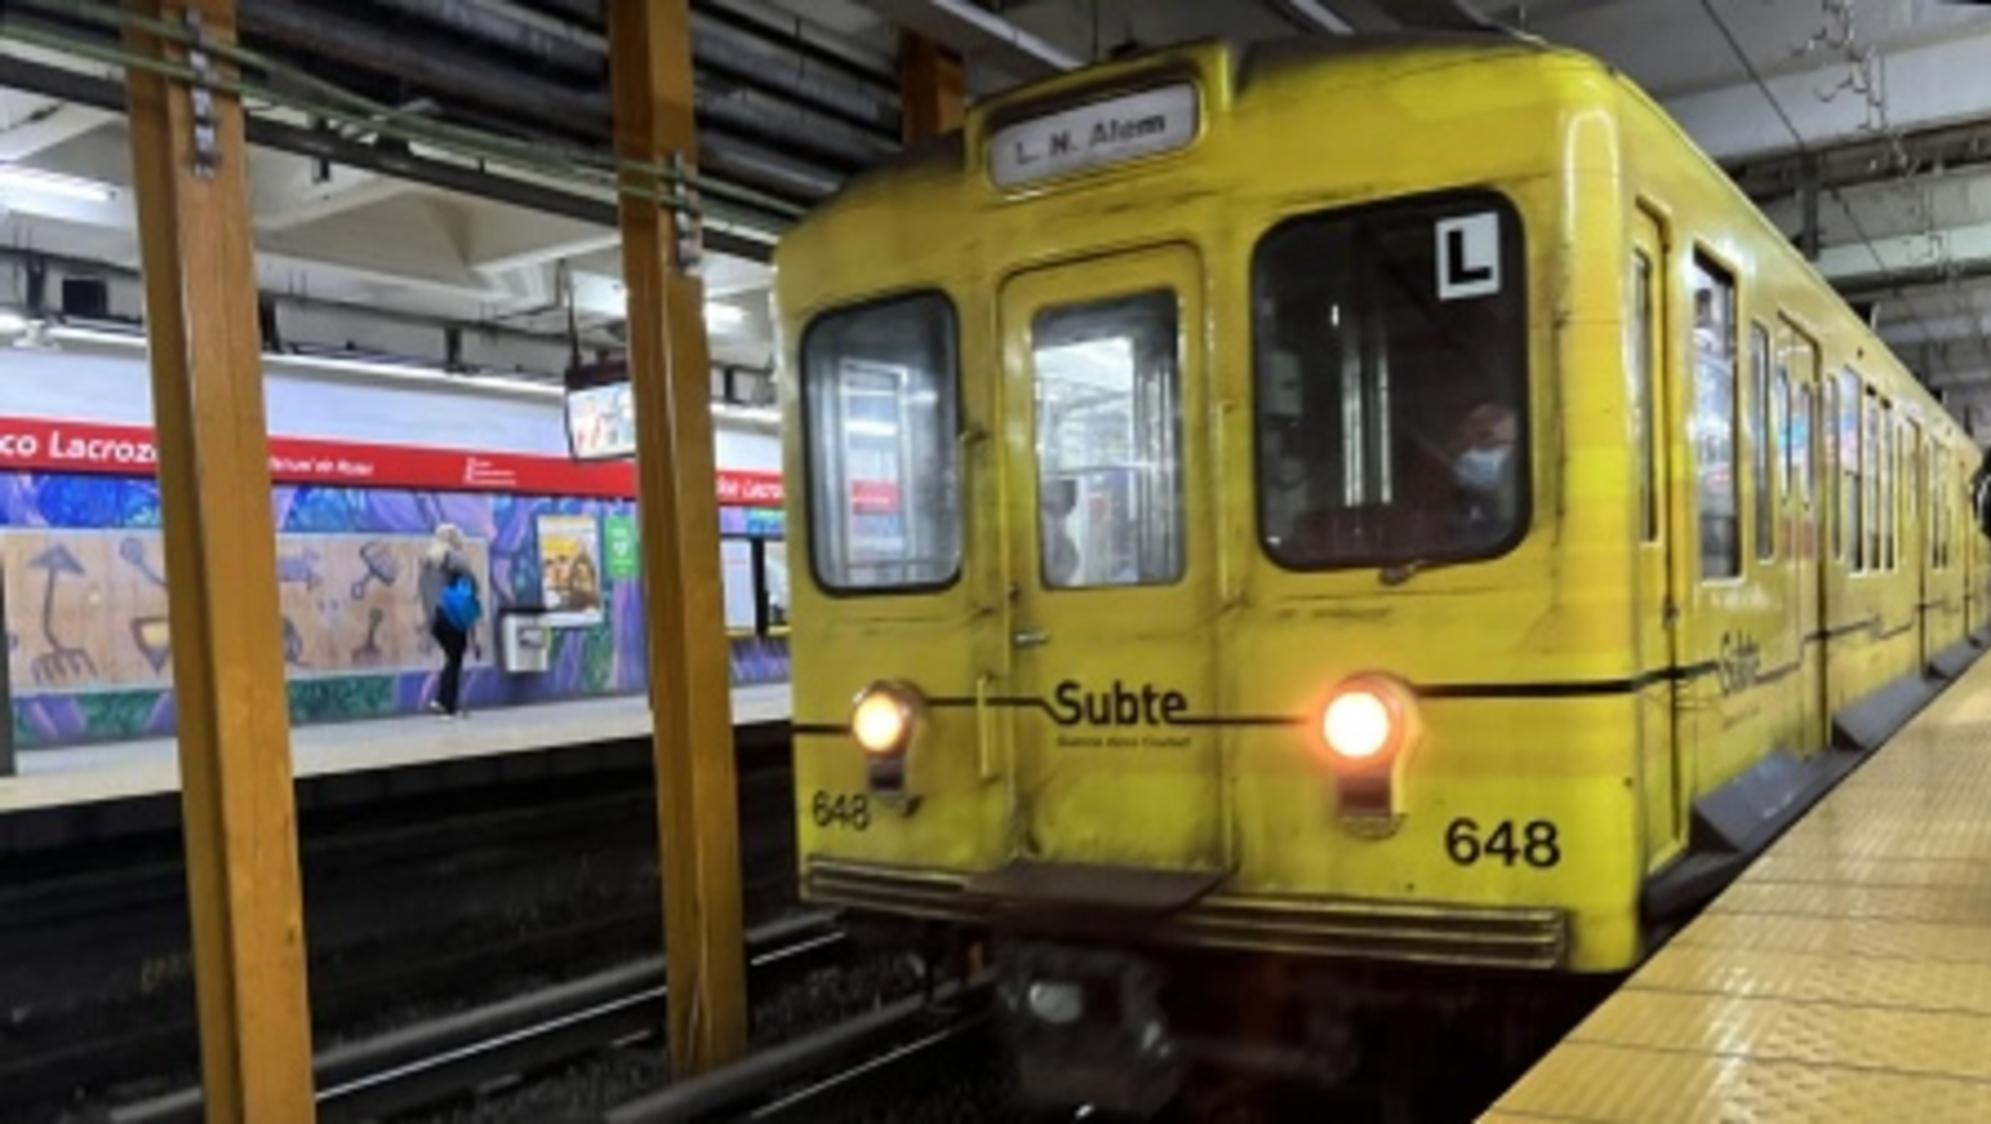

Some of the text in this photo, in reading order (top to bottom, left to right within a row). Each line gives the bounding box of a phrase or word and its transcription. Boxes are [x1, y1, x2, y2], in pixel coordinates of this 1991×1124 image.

[1089, 113, 1166, 148] Alem
[1448, 229, 1492, 285] L
[1055, 679, 1188, 725] Subte
[813, 789, 871, 832] 648
[1445, 816, 1562, 868] 648
